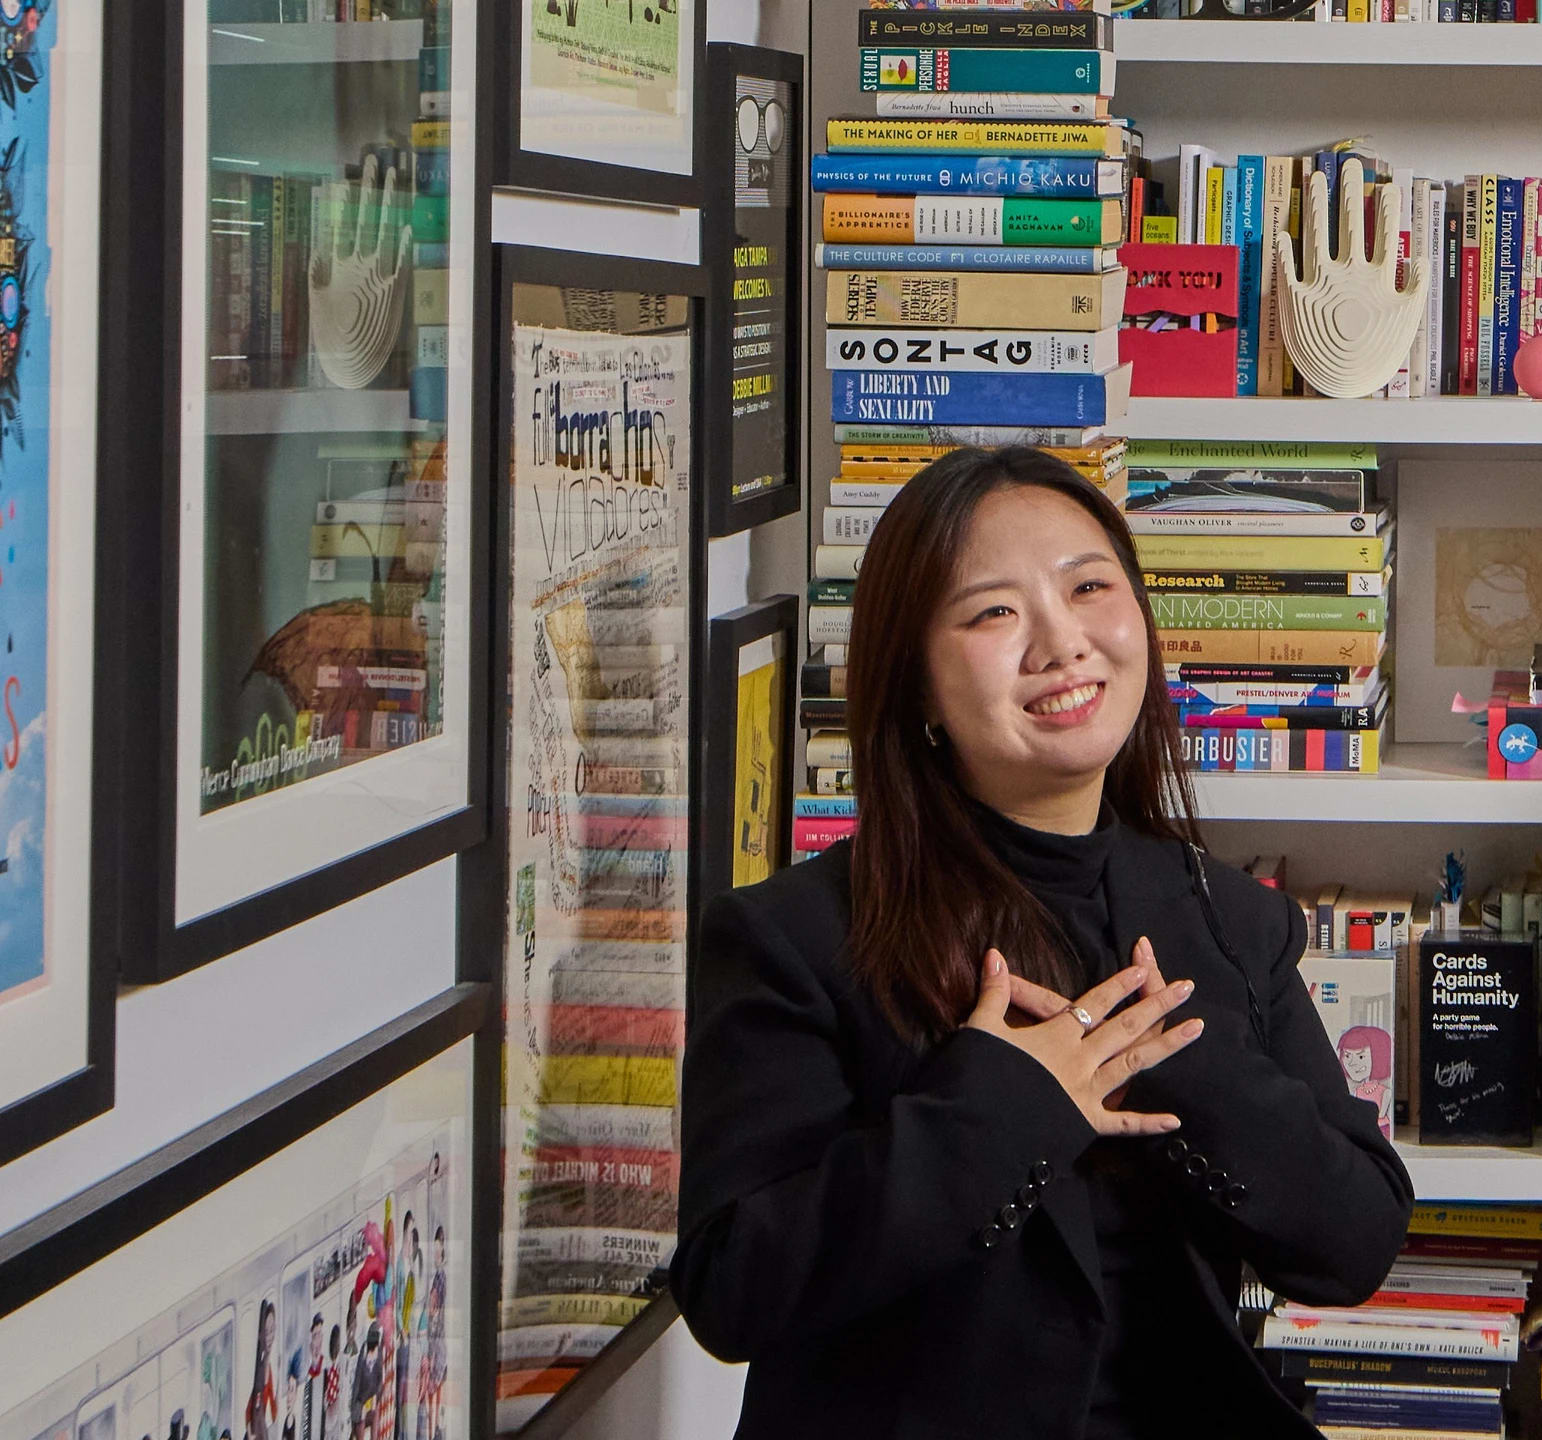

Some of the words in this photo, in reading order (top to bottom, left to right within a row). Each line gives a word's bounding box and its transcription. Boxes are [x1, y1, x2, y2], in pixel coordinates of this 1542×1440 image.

[949, 101, 994, 115] hunch
[843, 128, 865, 139] THE
[868, 128, 914, 140] MAKING
[917, 129, 934, 141] OF
[938, 129, 958, 141] HER
[986, 131, 1059, 143] BERNADETTE
[1062, 132, 1089, 144] JIWA
[960, 172, 1033, 186] MICHIO
[1040, 173, 1091, 187] KAKU
[1500, 211, 1514, 267] Emotional
[1495, 271, 1514, 326] Intelligence
[841, 338, 1033, 365] SONTAG
[860, 373, 919, 396] LIBERTY
[923, 375, 950, 396] AND
[858, 399, 936, 421] SEXUALITY
[1143, 573, 1225, 588] Research
[1432, 953, 1487, 970] Cards
[1432, 971, 1502, 991] Against
[1432, 990, 1519, 1008] Humanity
[1441, 1014, 1460, 1023] party
[1462, 1015, 1480, 1023] game
[1444, 1023, 1470, 1031] horrible
